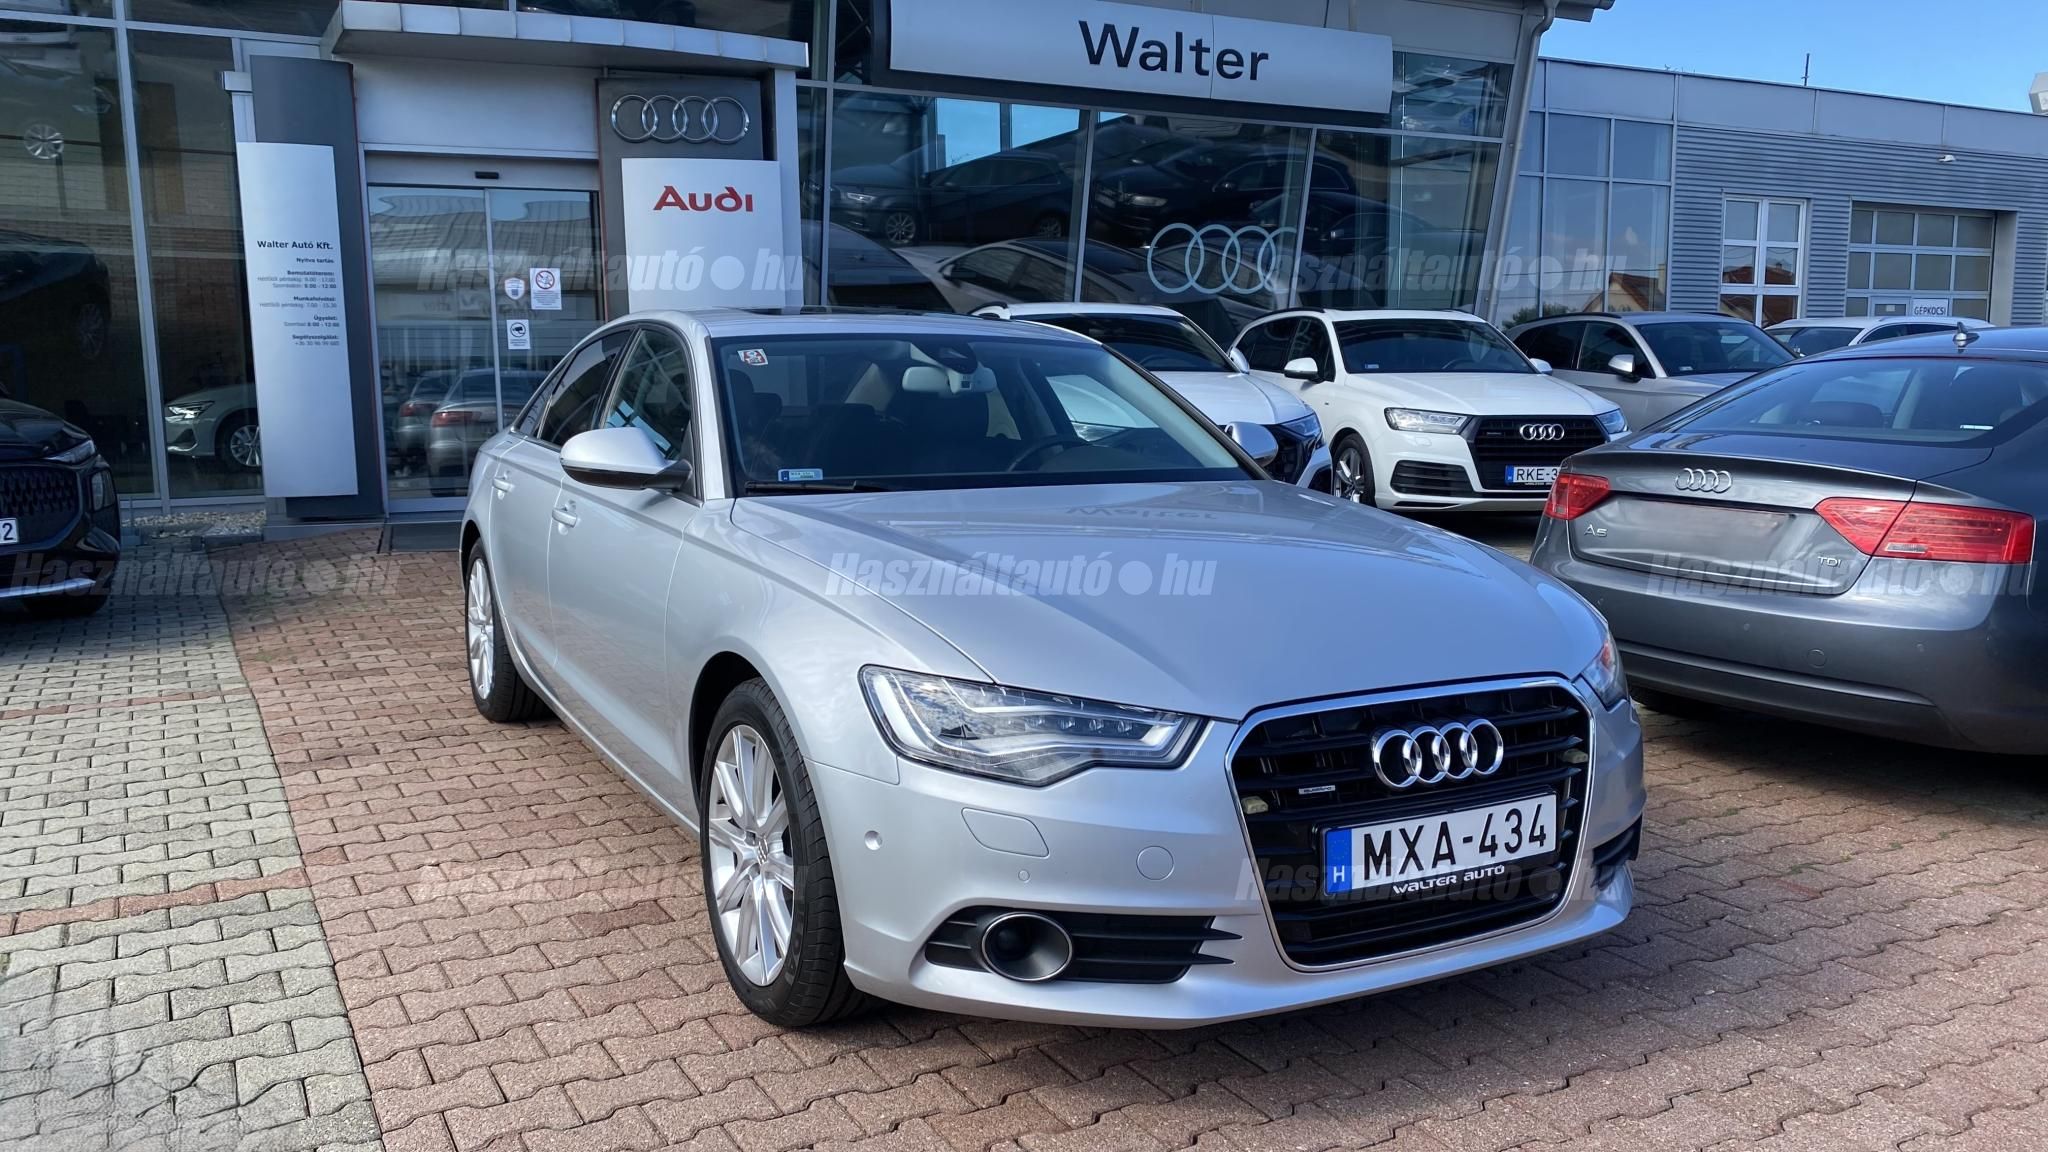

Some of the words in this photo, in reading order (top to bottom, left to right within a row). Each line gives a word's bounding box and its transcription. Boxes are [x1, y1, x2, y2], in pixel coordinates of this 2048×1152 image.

[1078, 19, 1268, 81] Walter
[653, 185, 753, 212] Audi
[257, 240, 288, 248] Walter
[291, 240, 314, 249] Autó
[316, 241, 333, 249] Kft.
[1584, 523, 1607, 537] A5
[1818, 556, 1842, 568] TDI
[1363, 803, 1547, 881] MXA-434
[1333, 865, 1345, 884] H
